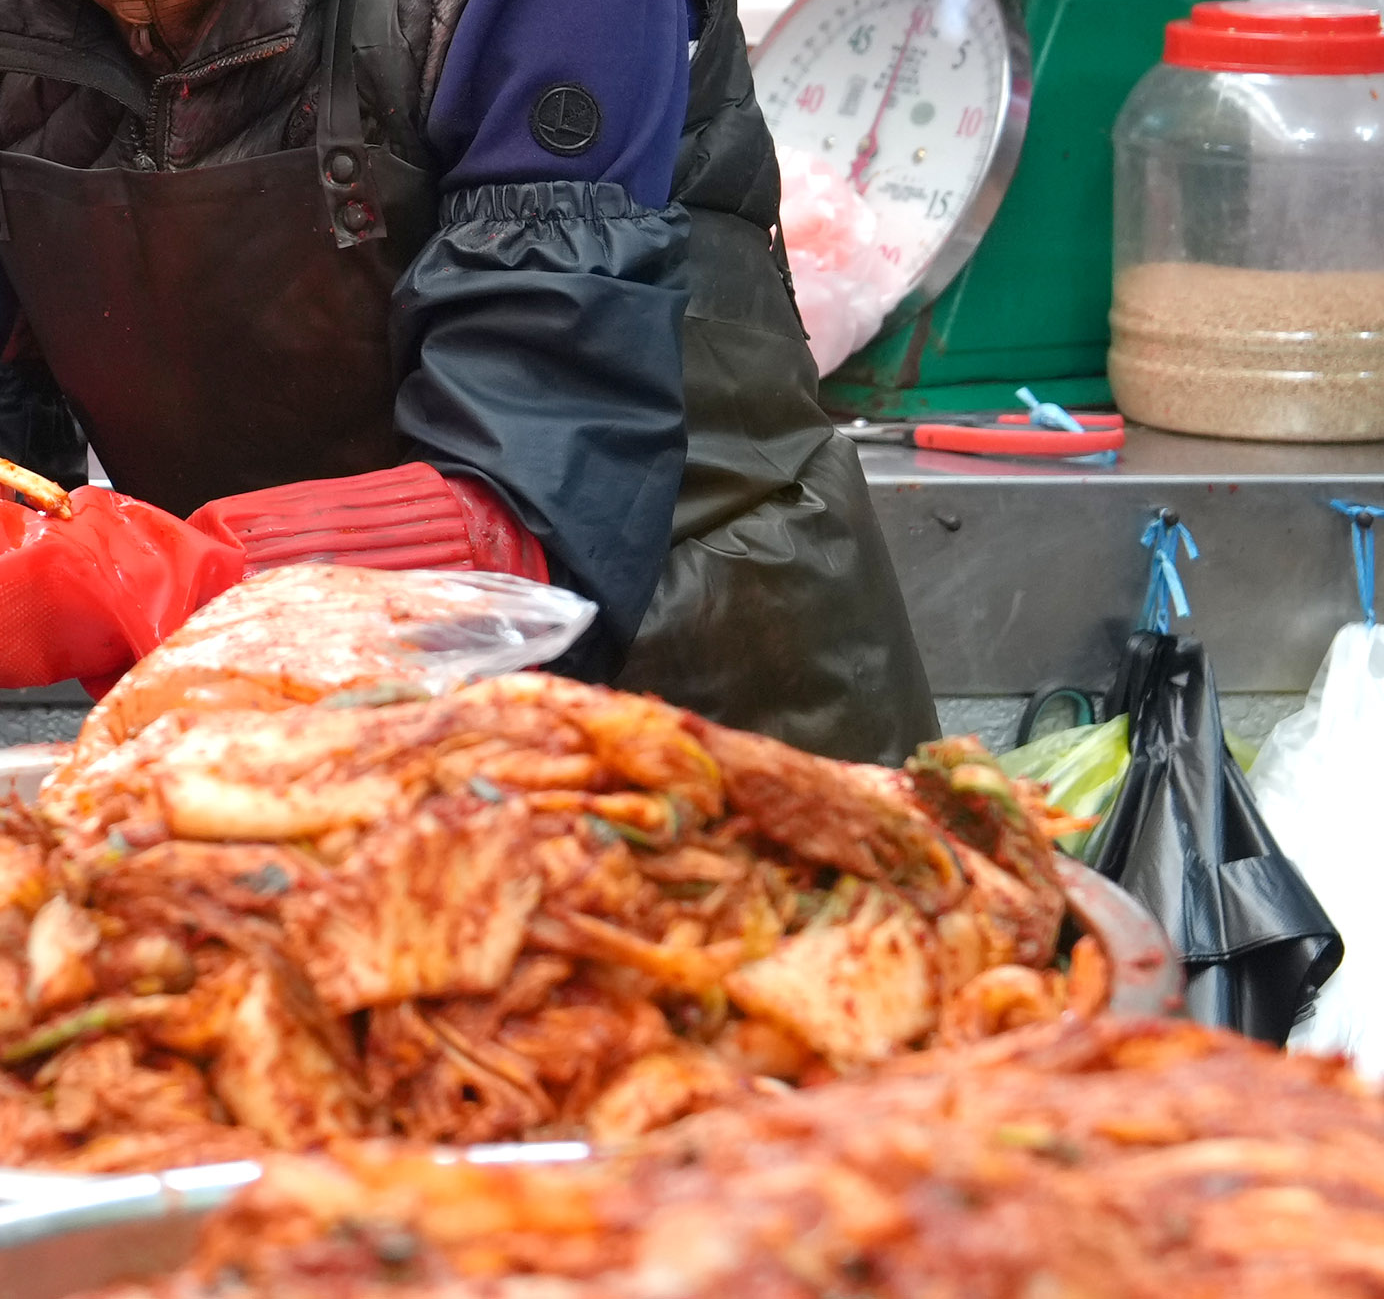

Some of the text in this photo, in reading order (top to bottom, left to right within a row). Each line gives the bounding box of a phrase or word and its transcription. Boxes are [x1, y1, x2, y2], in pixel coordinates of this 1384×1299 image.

[848, 24, 876, 55] 45
[951, 38, 972, 70] 5
[796, 83, 826, 115] 40
[954, 105, 984, 139] 10
[924, 189, 954, 221] 15
